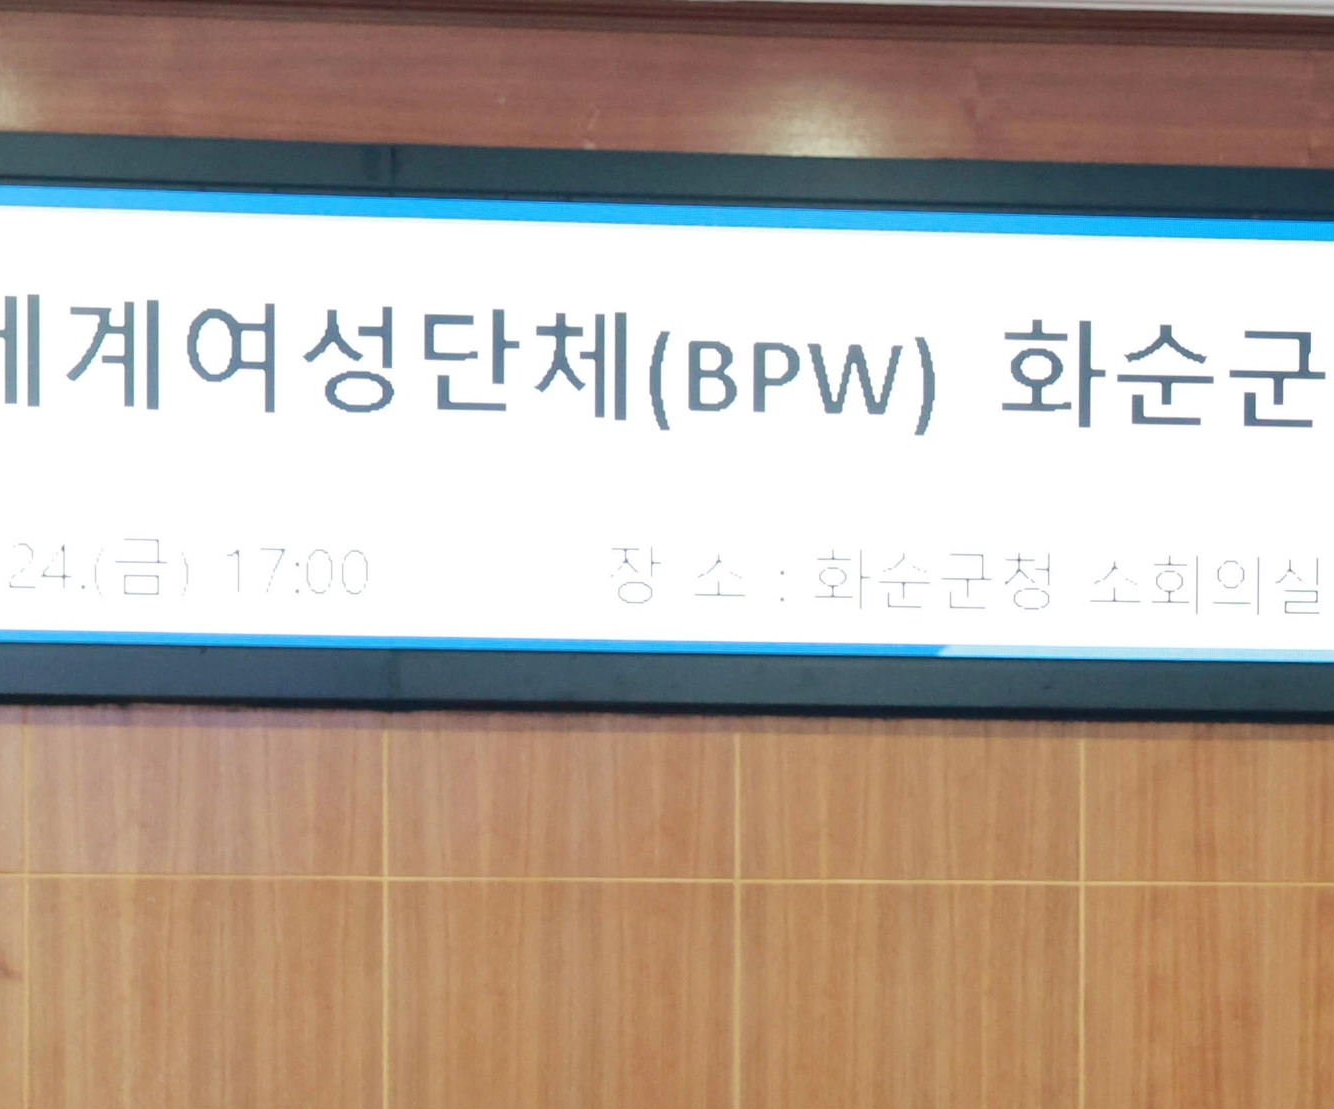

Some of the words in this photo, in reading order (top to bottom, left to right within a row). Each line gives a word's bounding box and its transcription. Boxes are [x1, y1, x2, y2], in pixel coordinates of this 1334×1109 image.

[1002, 320, 1326, 428] 화순군
[8, 537, 188, 597] 24.(금)
[226, 547, 369, 595] 17:00
[814, 549, 1052, 610] 화순군청
[1090, 556, 1321, 615] 소회의실
